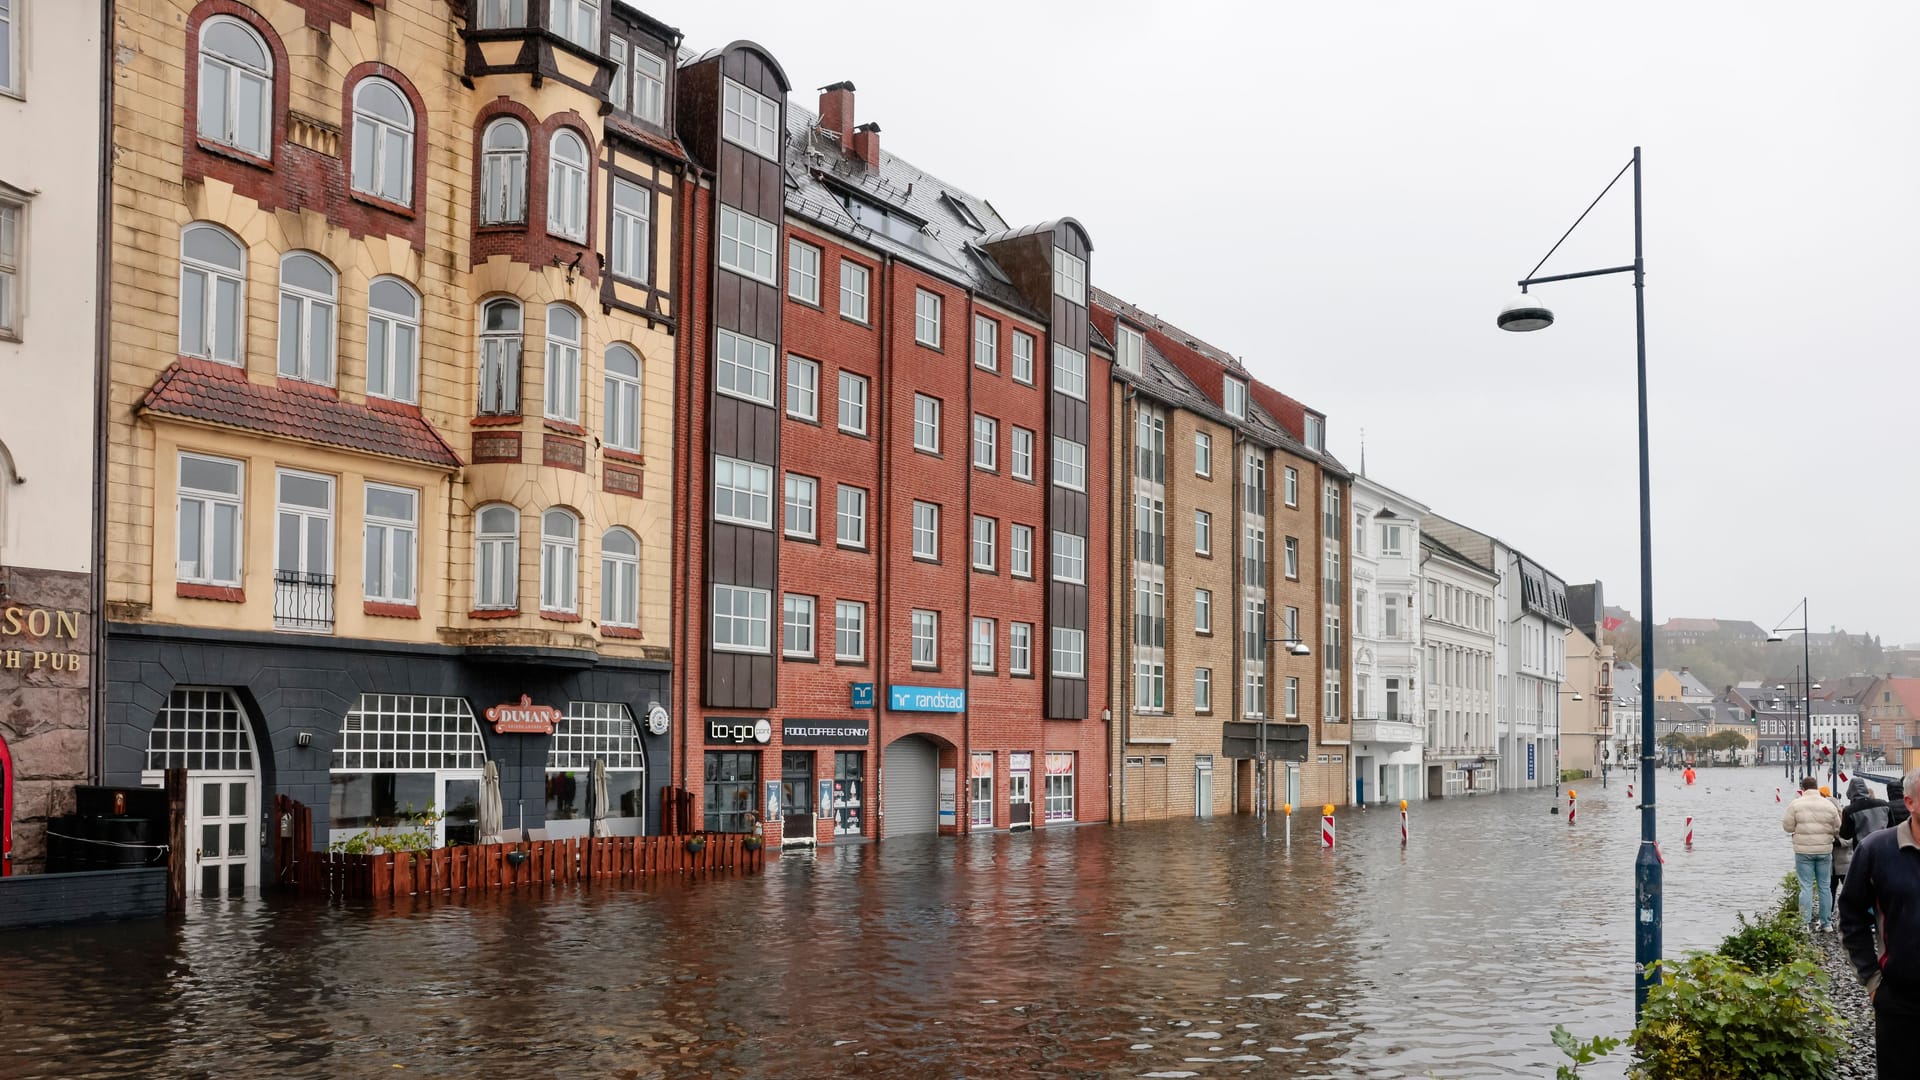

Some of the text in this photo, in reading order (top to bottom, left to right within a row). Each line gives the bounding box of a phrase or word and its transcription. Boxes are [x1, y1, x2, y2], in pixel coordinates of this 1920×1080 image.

[0, 650, 80, 671] H PUB
[915, 691, 963, 708] randstad
[501, 710, 550, 722] DUMAN
[712, 721, 754, 743] to-go
[807, 727, 837, 736] COFFEE
[837, 728, 844, 736] &
[844, 728, 869, 737] CANDY
